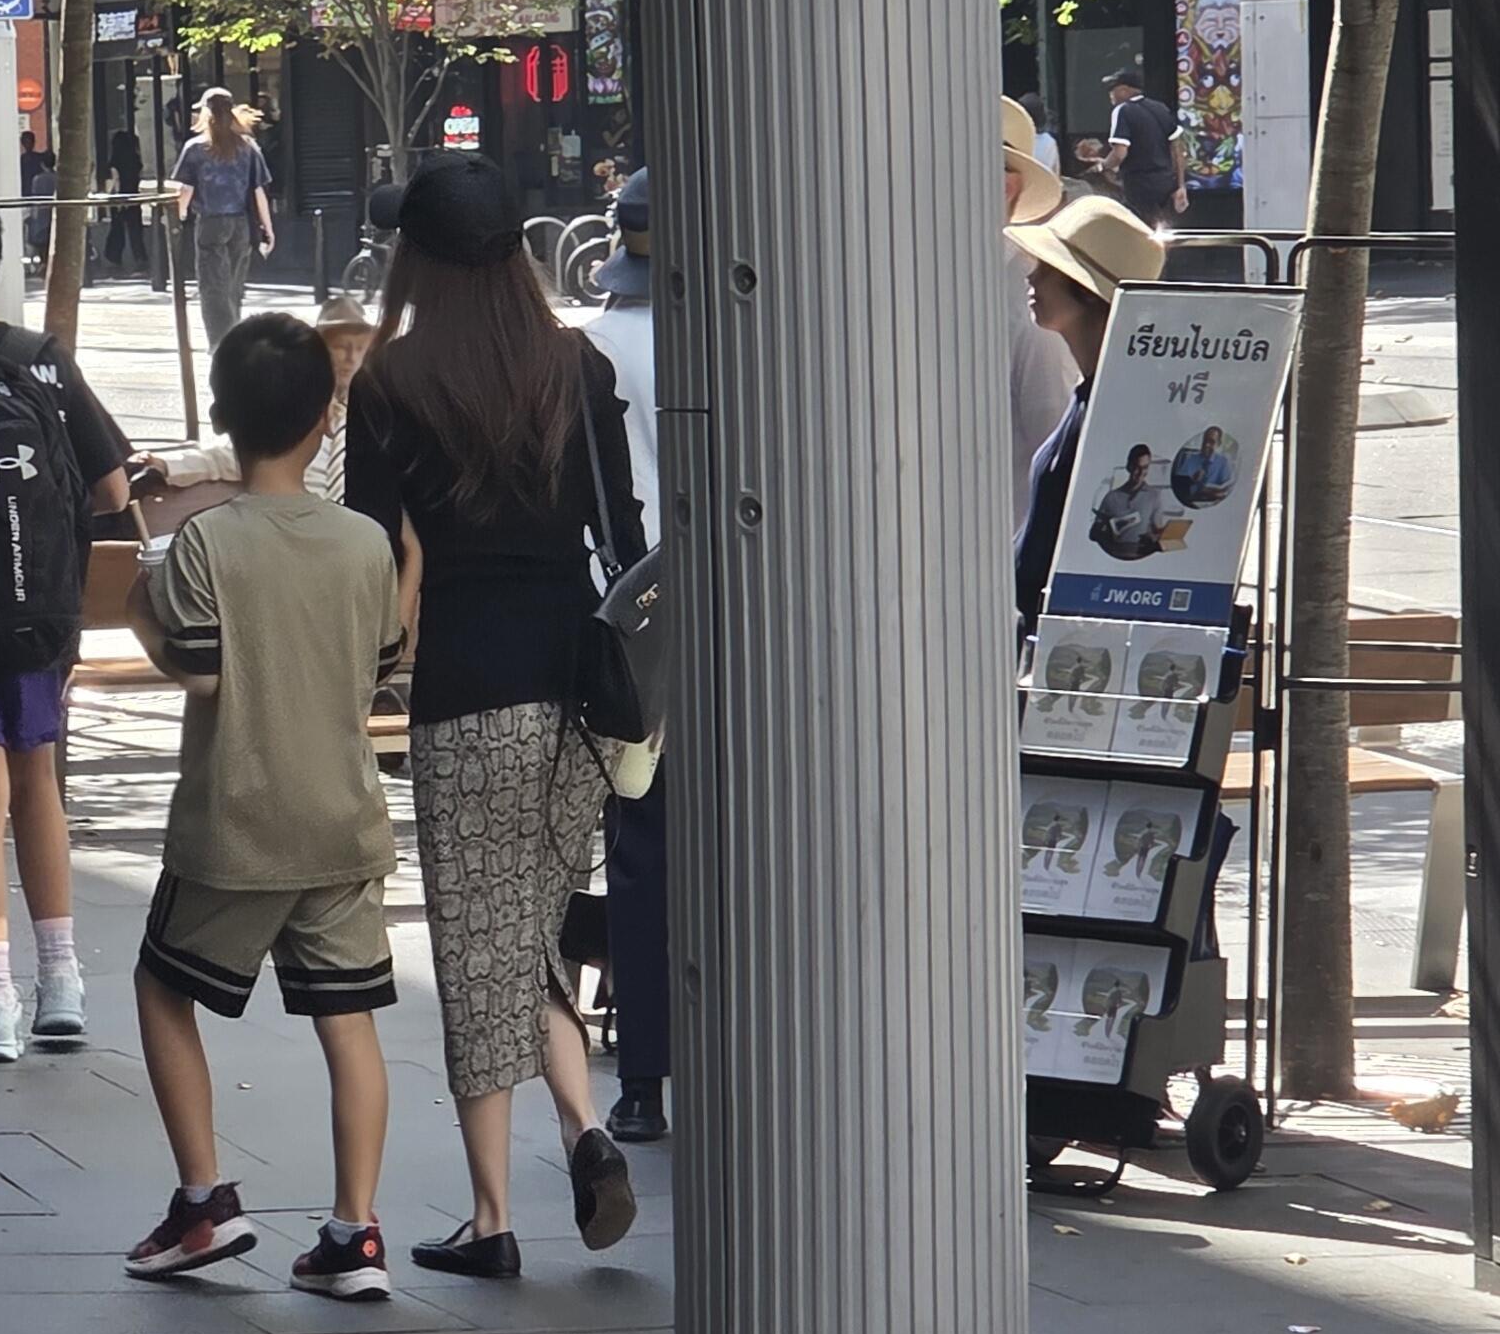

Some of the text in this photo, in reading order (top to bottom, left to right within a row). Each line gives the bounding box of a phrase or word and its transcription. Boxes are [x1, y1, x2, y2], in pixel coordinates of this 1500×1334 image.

[1127, 323, 1270, 362] เรียนไบเบิล
[1167, 371, 1210, 404] ฟรี
[7, 495, 26, 602] UNDER ARMOUR
[1103, 589, 1163, 606] JW.ORG
